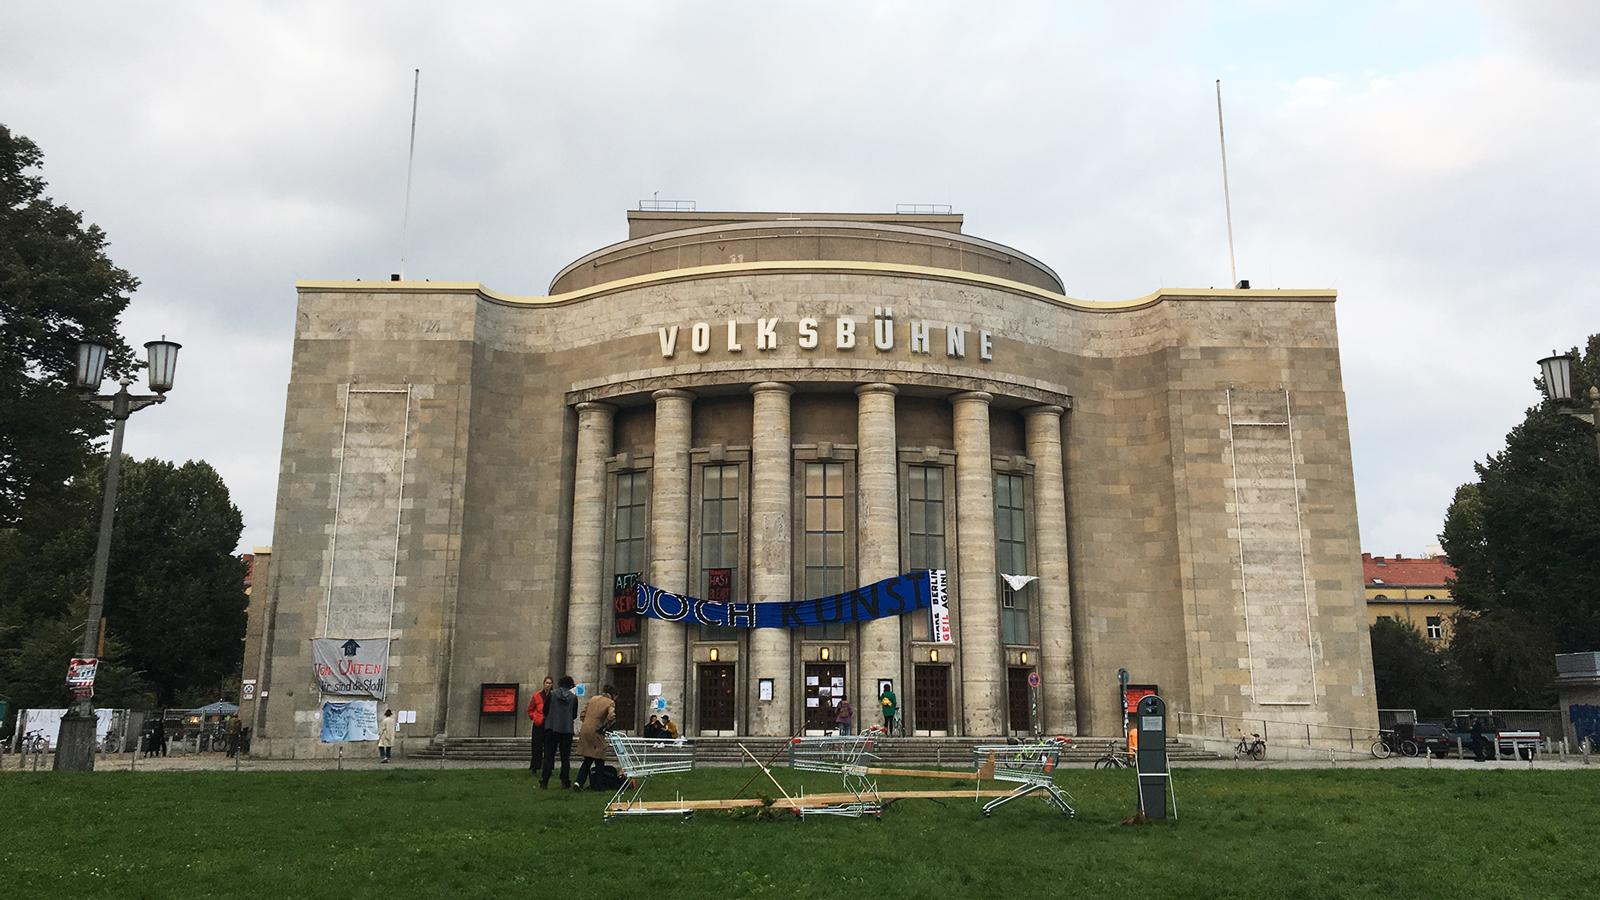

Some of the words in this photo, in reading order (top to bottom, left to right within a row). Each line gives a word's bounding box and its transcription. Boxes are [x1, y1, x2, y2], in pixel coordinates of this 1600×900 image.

[658, 306, 993, 361] VOLKSBÜHNE
[635, 581, 756, 628] DOCH
[781, 573, 928, 628] KUNST
[930, 568, 939, 605] BERLIN
[942, 614, 950, 641] GEIL
[338, 659, 382, 676] UNTEN
[334, 680, 352, 692] sind
